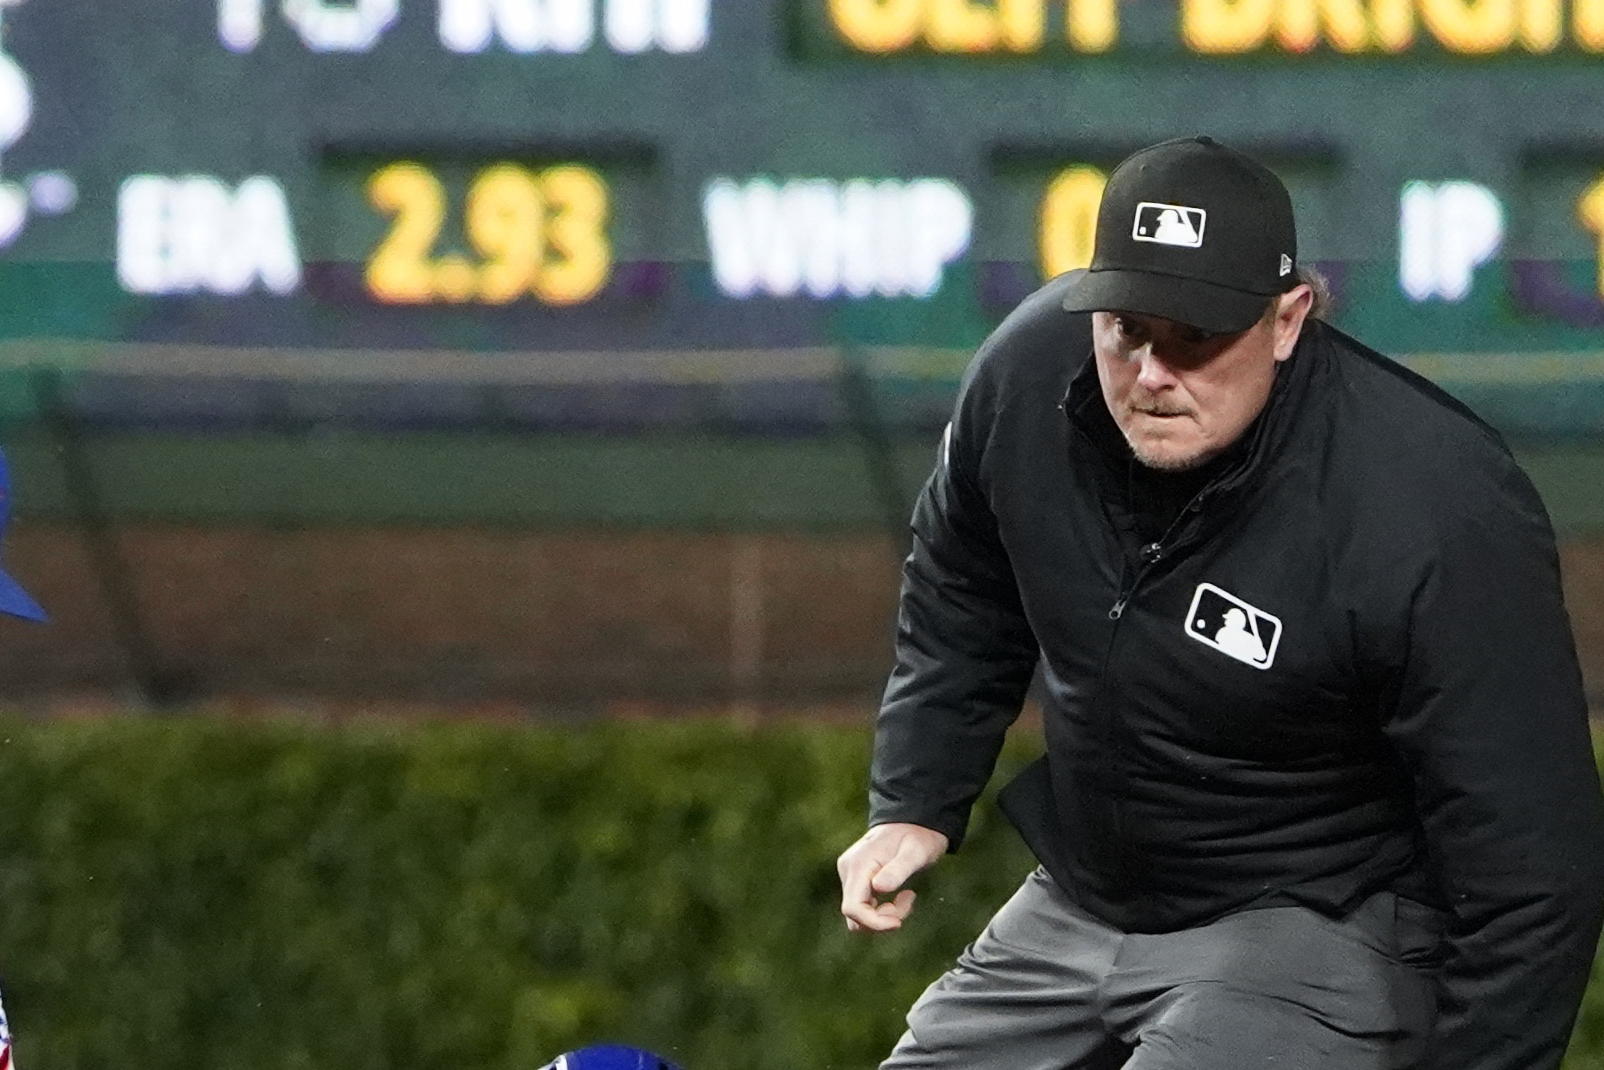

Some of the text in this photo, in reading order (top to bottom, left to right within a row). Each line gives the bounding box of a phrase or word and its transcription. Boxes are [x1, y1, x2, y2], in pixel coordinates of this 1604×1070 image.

[117, 174, 303, 295] ERA
[366, 163, 613, 306] 2.93
[702, 174, 973, 298] WHIP
[1399, 180, 1504, 300] IP
